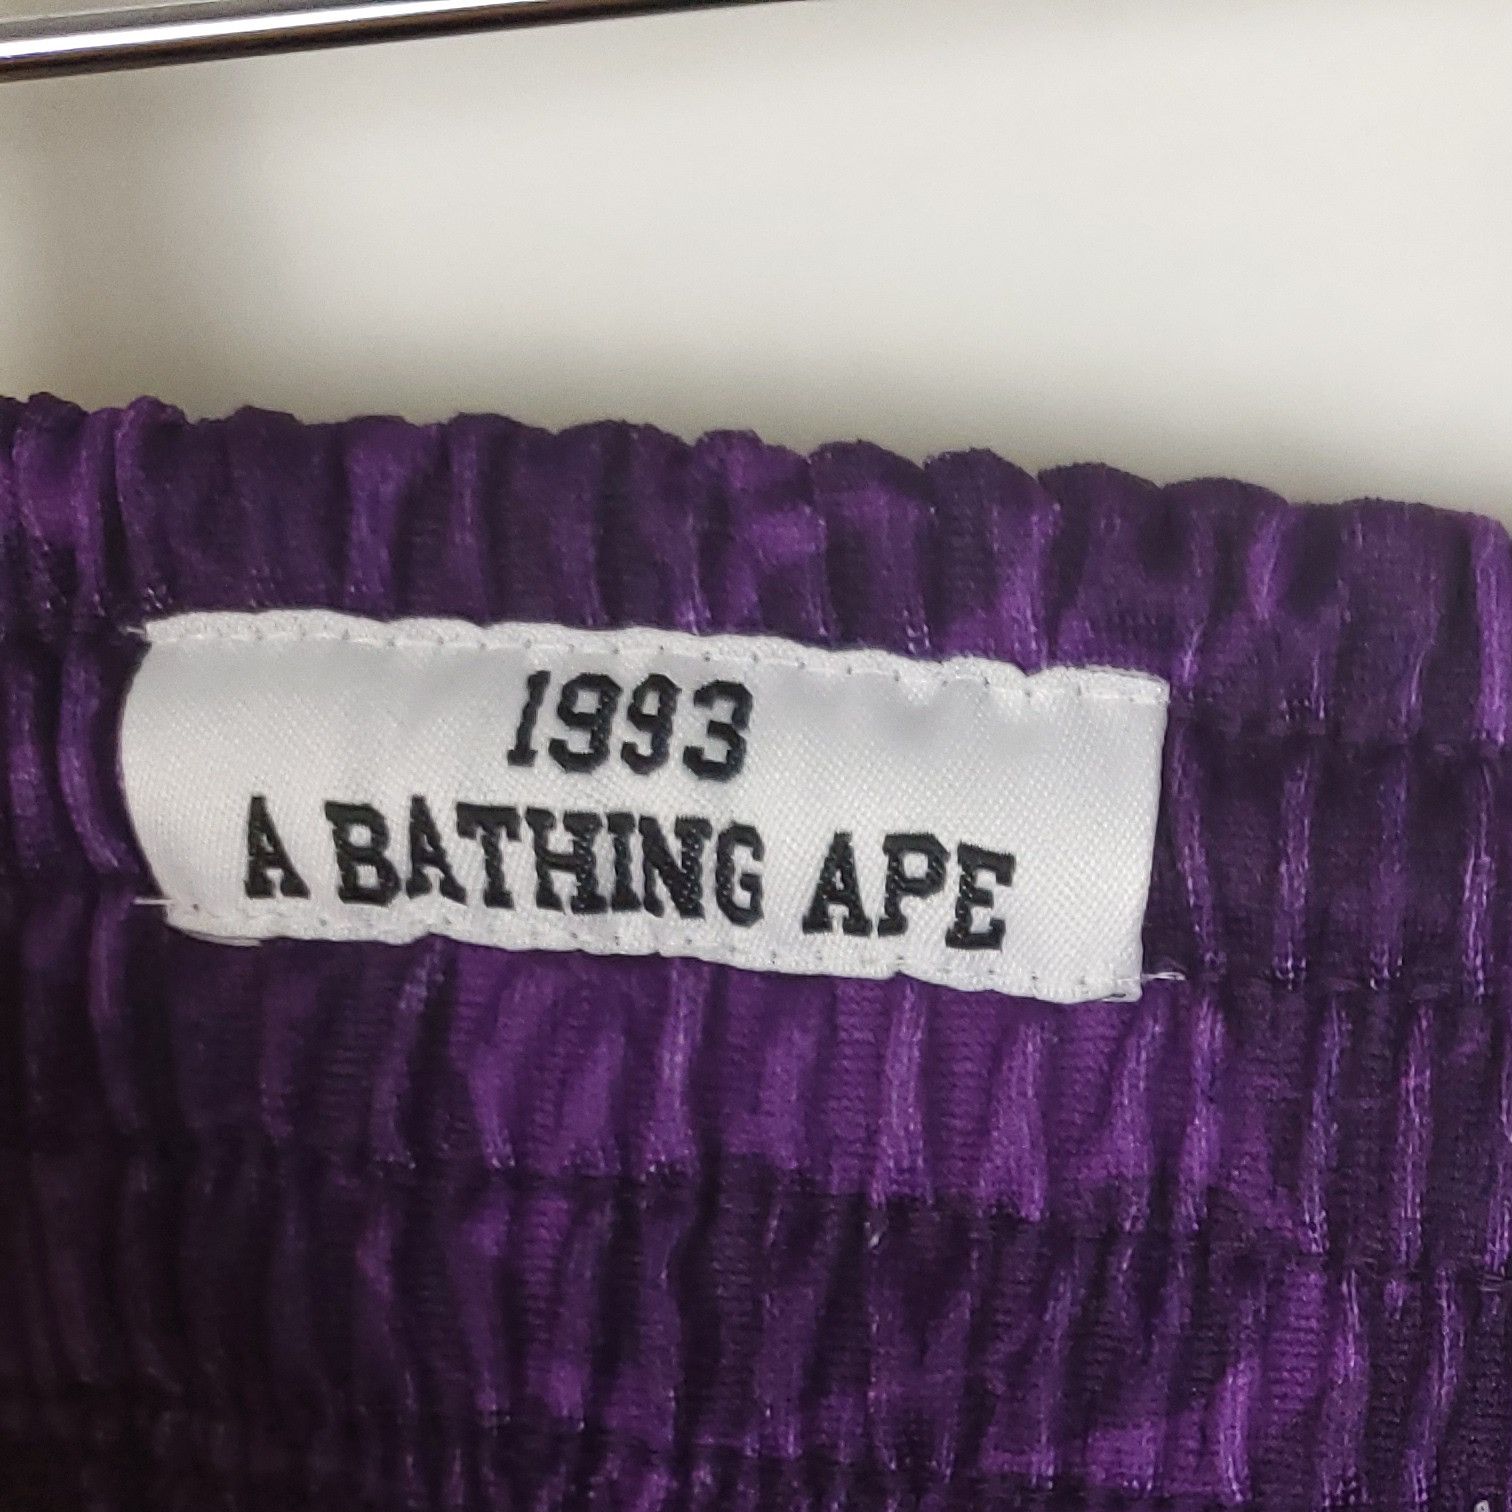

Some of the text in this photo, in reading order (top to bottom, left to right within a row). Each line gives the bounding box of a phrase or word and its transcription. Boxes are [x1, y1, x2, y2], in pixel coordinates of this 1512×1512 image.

[506, 668, 755, 783] 1993
[242, 795, 1016, 950] A BATHING APE
